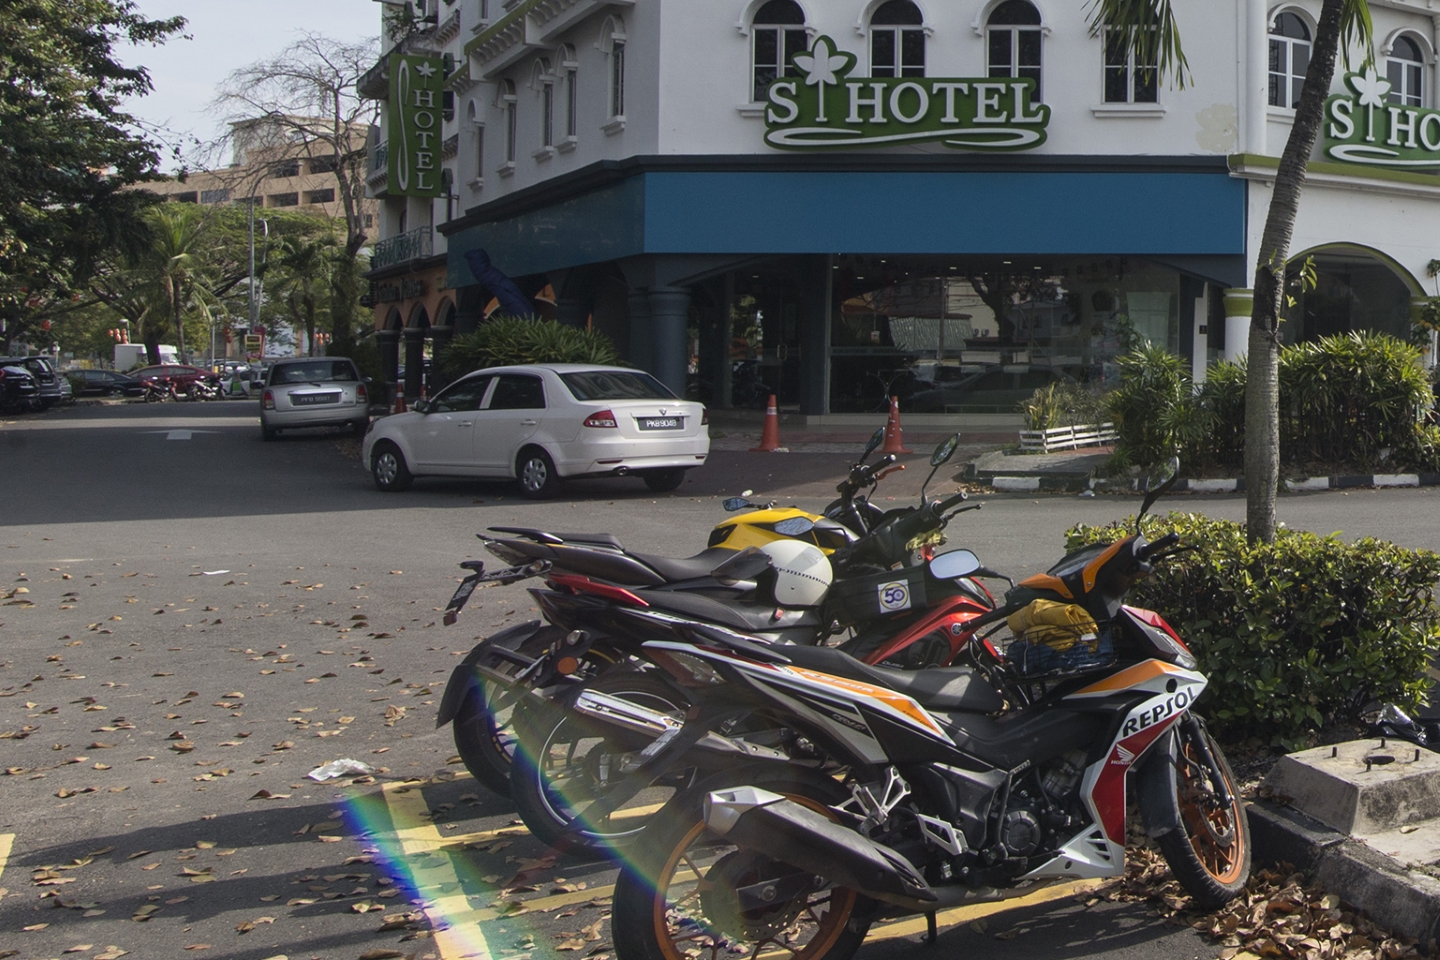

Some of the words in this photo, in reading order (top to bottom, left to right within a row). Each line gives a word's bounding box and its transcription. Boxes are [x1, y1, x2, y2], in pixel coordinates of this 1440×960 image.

[845, 82, 1043, 124] HOTEL
[413, 89, 435, 190] HOTEL
[1123, 686, 1197, 737] REPSOL
